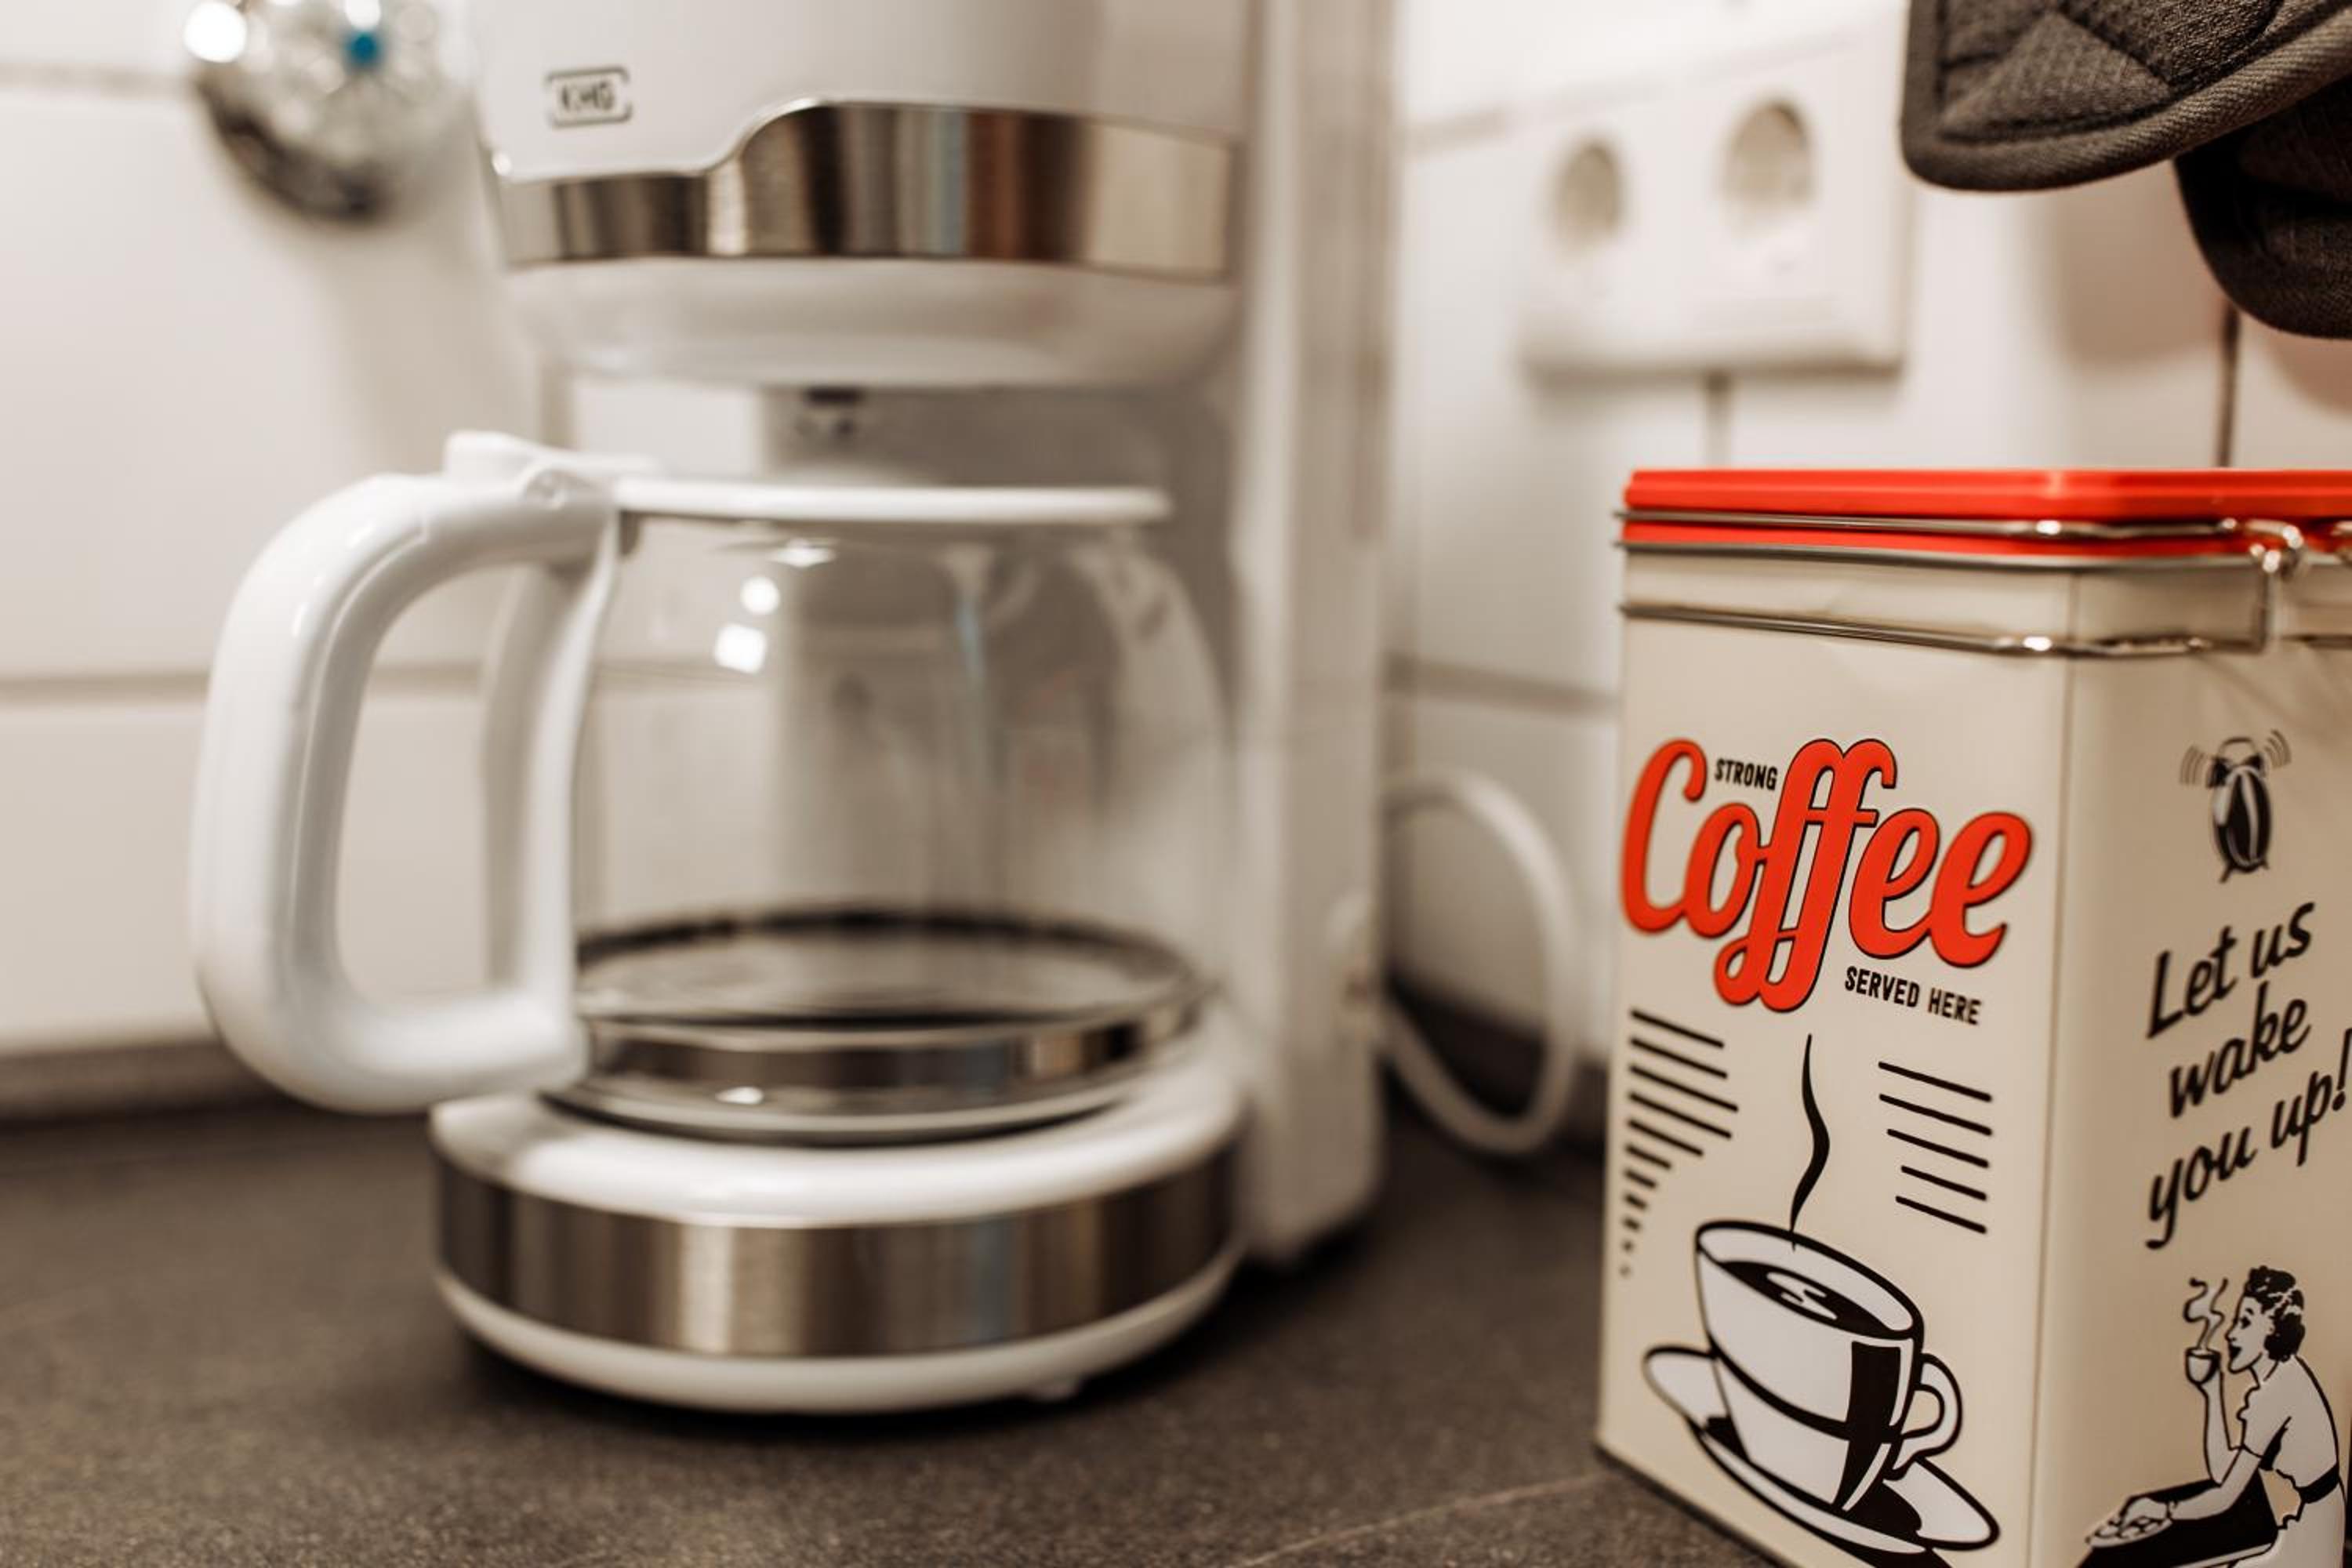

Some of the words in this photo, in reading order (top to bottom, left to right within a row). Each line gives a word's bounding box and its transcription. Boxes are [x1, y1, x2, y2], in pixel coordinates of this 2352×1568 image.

[1714, 758, 1778, 791] STRONG
[1621, 738, 2033, 1013] Coffee
[1844, 965, 1919, 1009] SERVED
[1928, 988, 1982, 1025] HERE
[2146, 925, 2238, 1040] Let
[2249, 902, 2316, 978] us
[2169, 980, 2310, 1118] wake
[2144, 1126, 2256, 1250] you
[2270, 1027, 2352, 1167] up!
